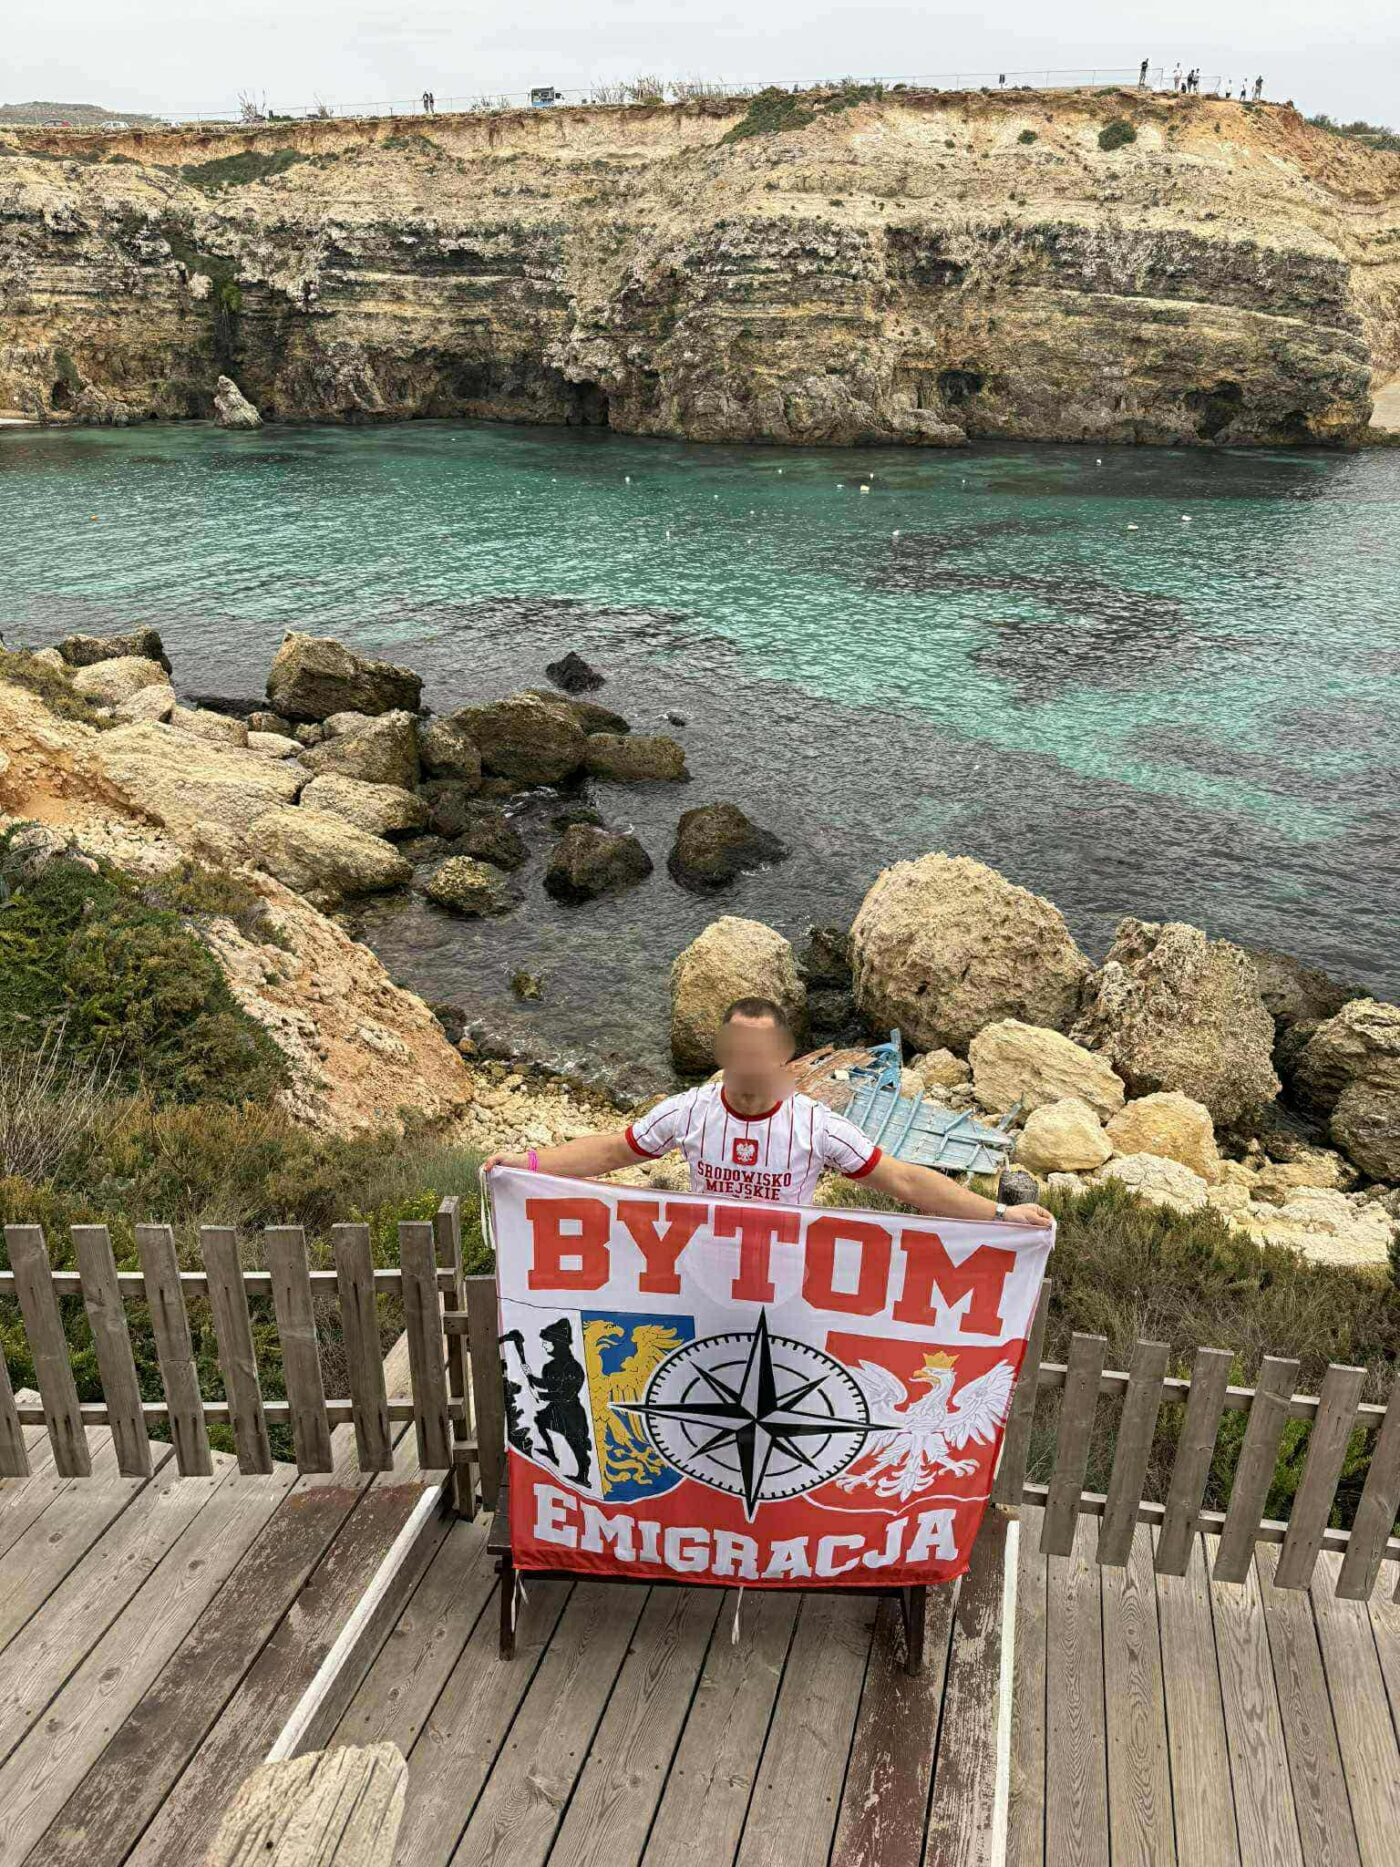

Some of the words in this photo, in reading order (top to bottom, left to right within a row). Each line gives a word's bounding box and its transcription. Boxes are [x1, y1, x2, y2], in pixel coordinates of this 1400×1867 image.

[706, 1179, 780, 1200] MIEJSKIE
[526, 1200, 1016, 1336] BYTOM
[533, 1484, 958, 1579] EMIGRACJA
